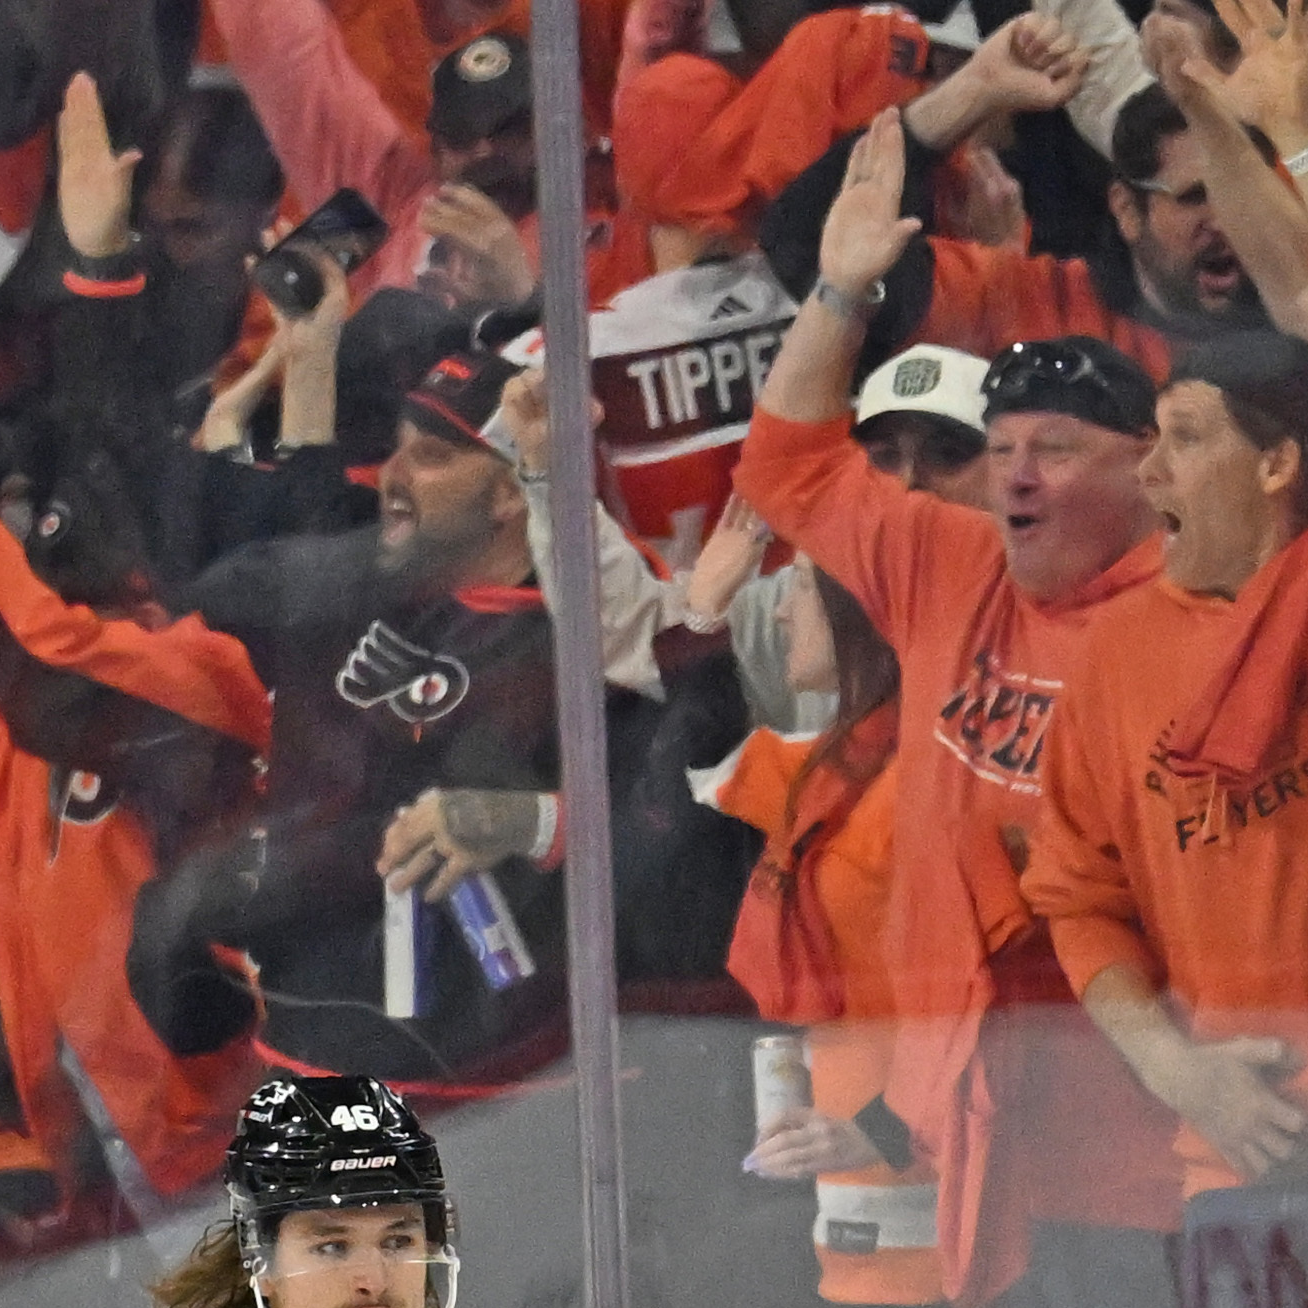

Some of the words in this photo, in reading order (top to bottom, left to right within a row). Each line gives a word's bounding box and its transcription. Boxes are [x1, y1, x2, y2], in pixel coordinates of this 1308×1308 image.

[627, 331, 786, 429] TIPPE
[330, 1104, 380, 1132] 46
[329, 1154, 397, 1172] BAUER
